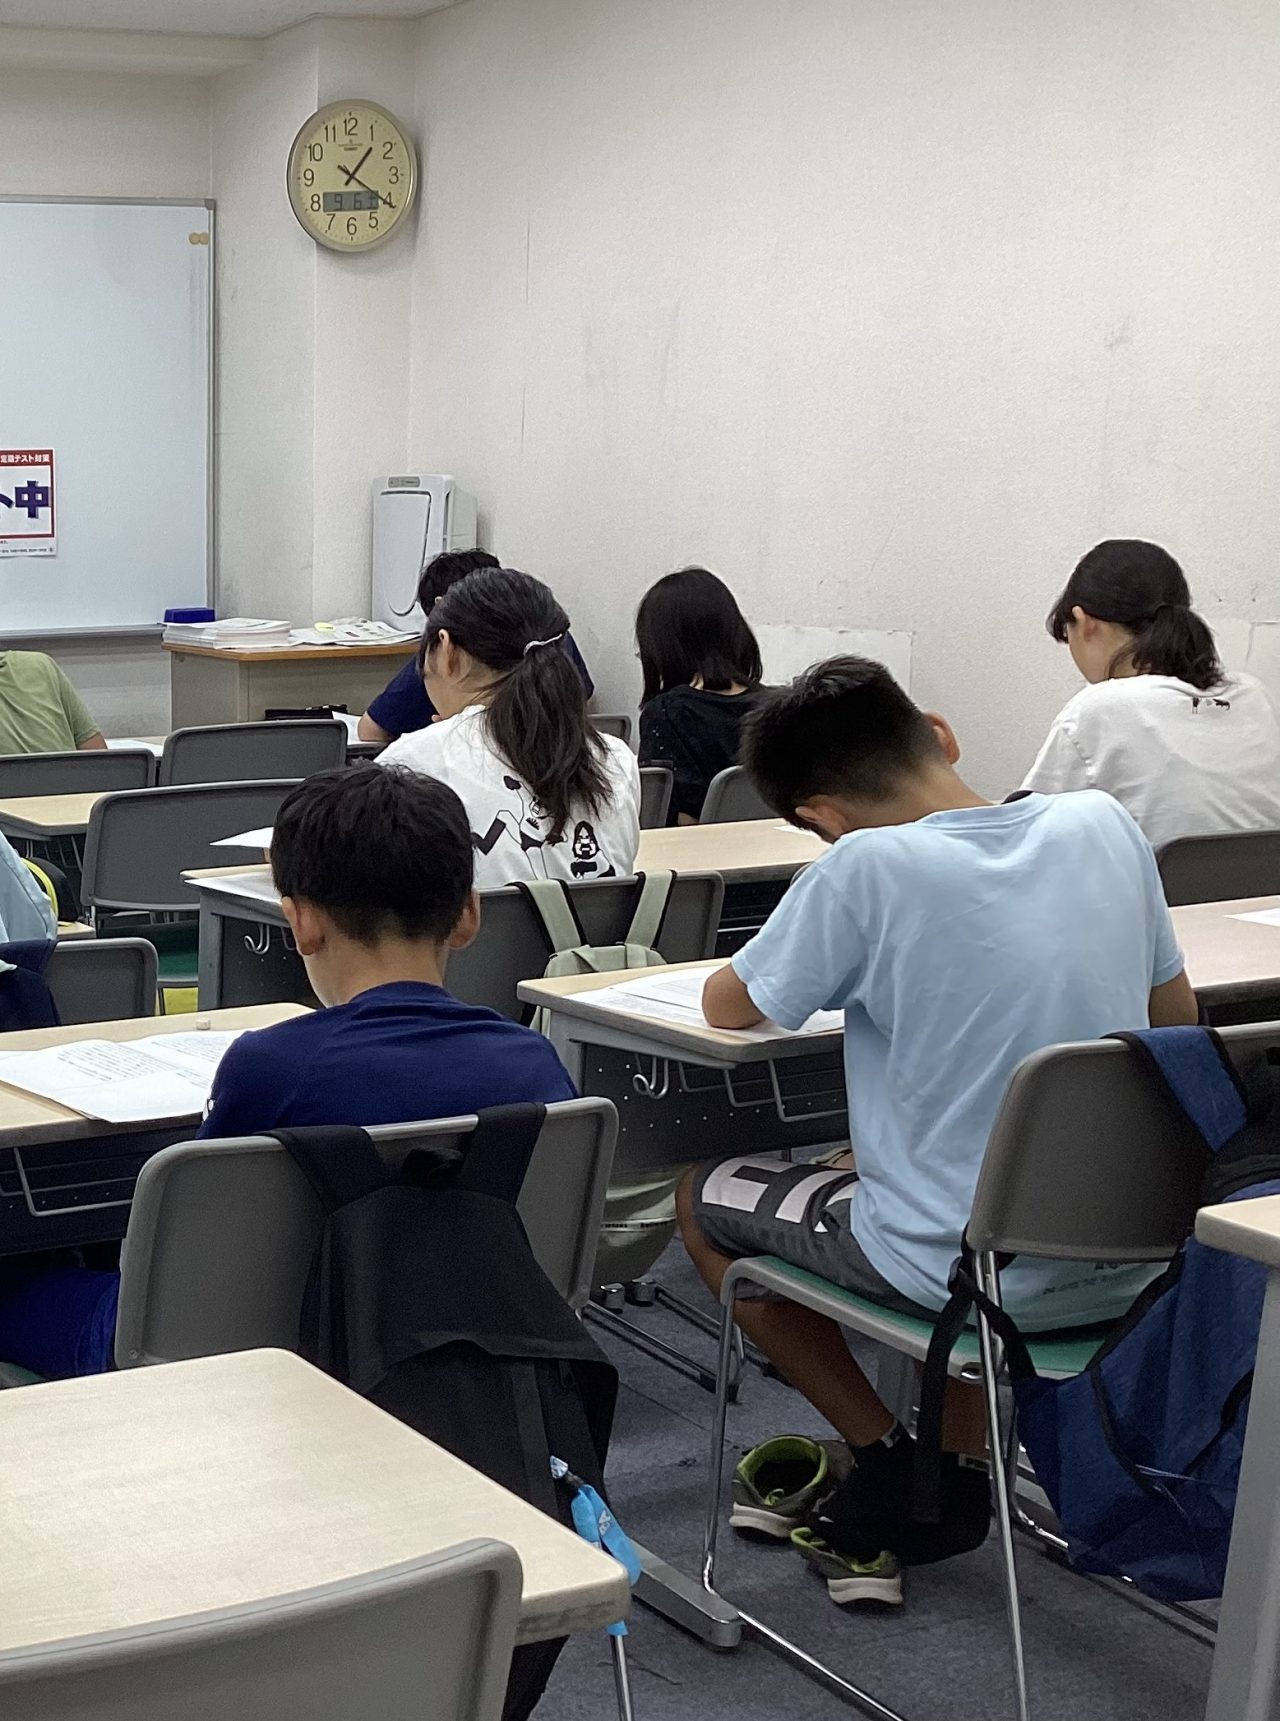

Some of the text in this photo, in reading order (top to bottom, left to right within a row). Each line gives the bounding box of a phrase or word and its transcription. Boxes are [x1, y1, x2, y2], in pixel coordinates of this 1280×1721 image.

[324, 124, 337, 142] 11
[343, 117, 359, 136] 12
[369, 124, 375, 142] 1
[308, 142, 324, 162] 10
[382, 141, 394, 160] 2
[303, 168, 315, 187] 9
[388, 166, 400, 184] 3
[310, 194, 322, 212] 8
[382, 192, 393, 209] 4
[326, 213, 336, 230] 7
[346, 217, 358, 236] 6
[368, 211, 379, 229] 5
